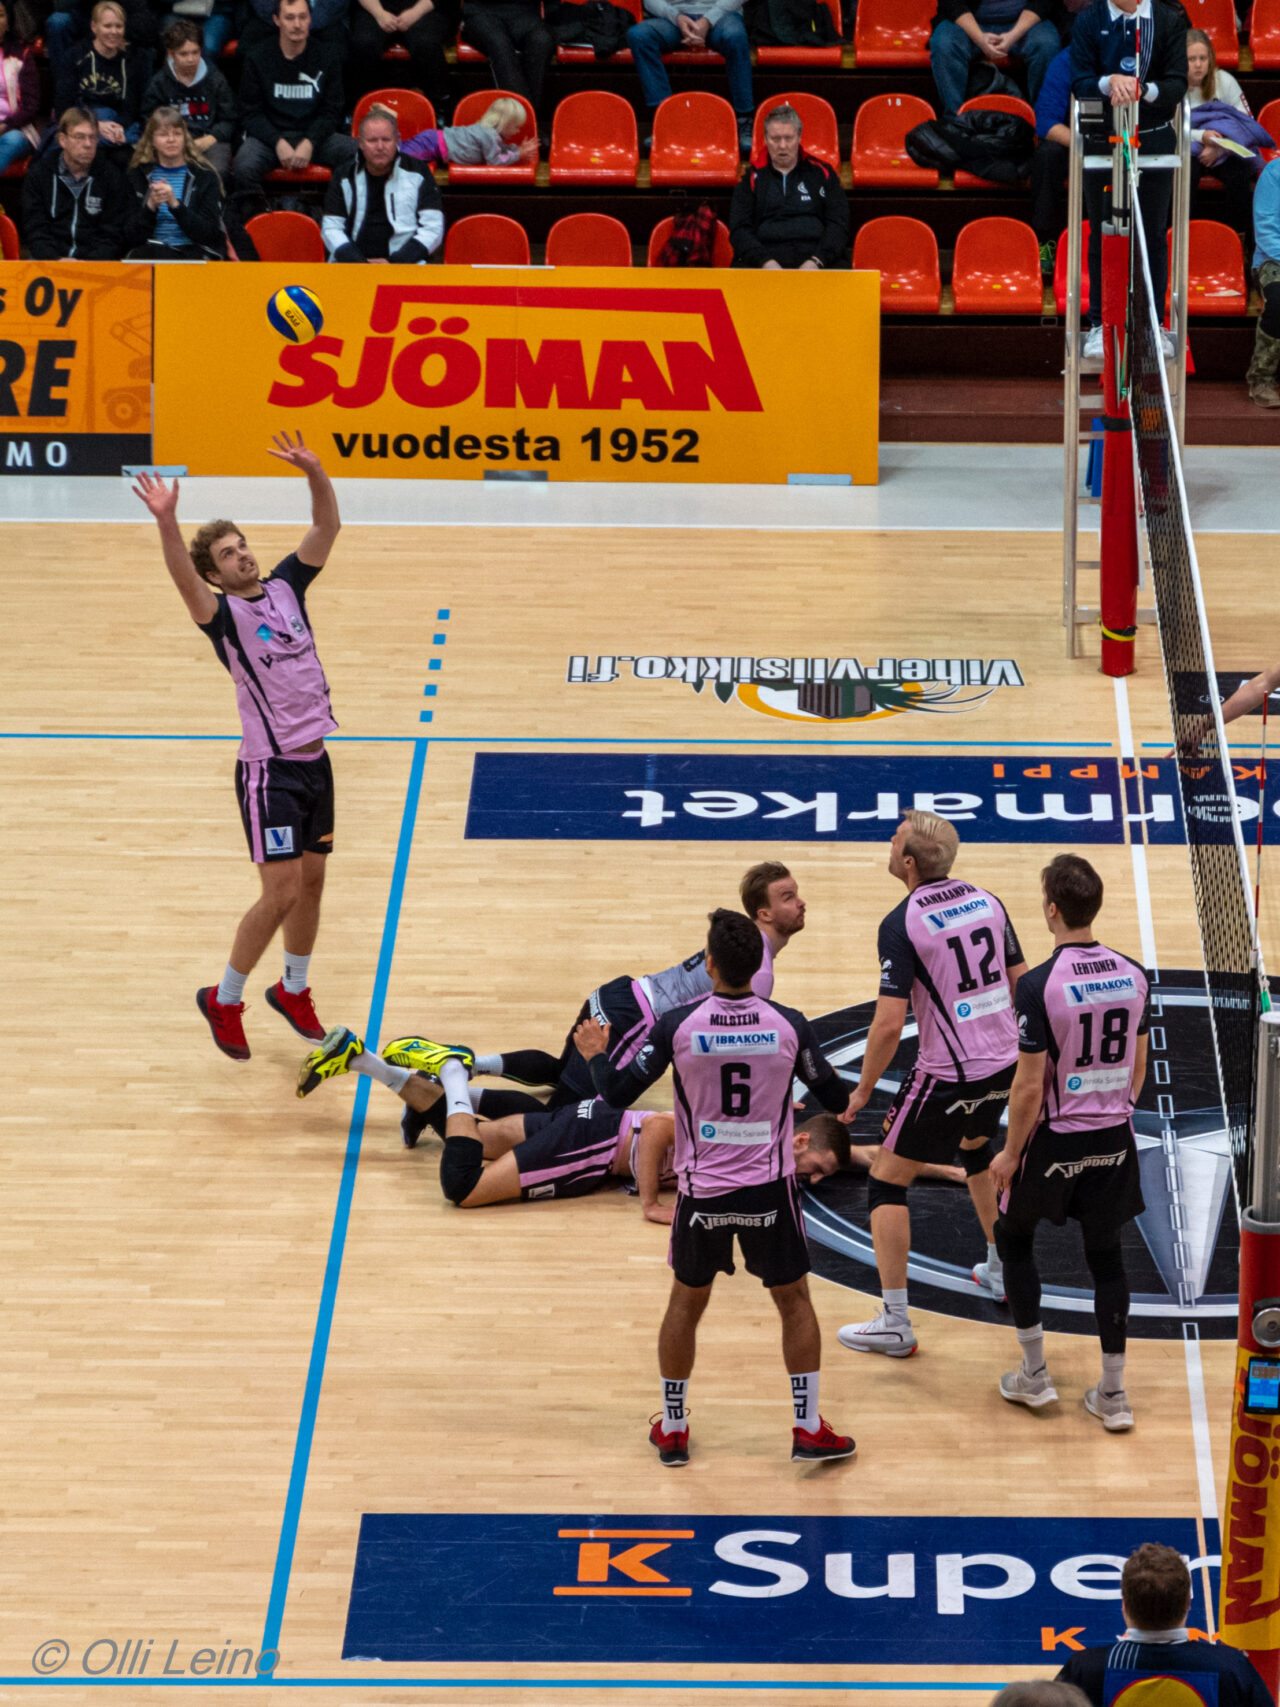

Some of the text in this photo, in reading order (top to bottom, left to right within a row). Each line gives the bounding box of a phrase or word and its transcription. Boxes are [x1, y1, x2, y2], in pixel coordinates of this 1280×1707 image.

[273, 82, 314, 99] PUMA
[24, 276, 84, 328] Oy
[267, 284, 764, 413] SJÖMAN
[333, 426, 700, 463] vuodesta 1952
[566, 655, 1026, 687] viherviisikko.fi
[927, 898, 989, 929] VIBRAKONE
[945, 926, 1002, 994] 12
[1071, 958, 1118, 976] LEHTONEN
[1070, 977, 1134, 1003] VIBRAKONE
[697, 1032, 777, 1053] VIBRAKONE
[1075, 1007, 1130, 1067] 18
[720, 1062, 752, 1118] 6
